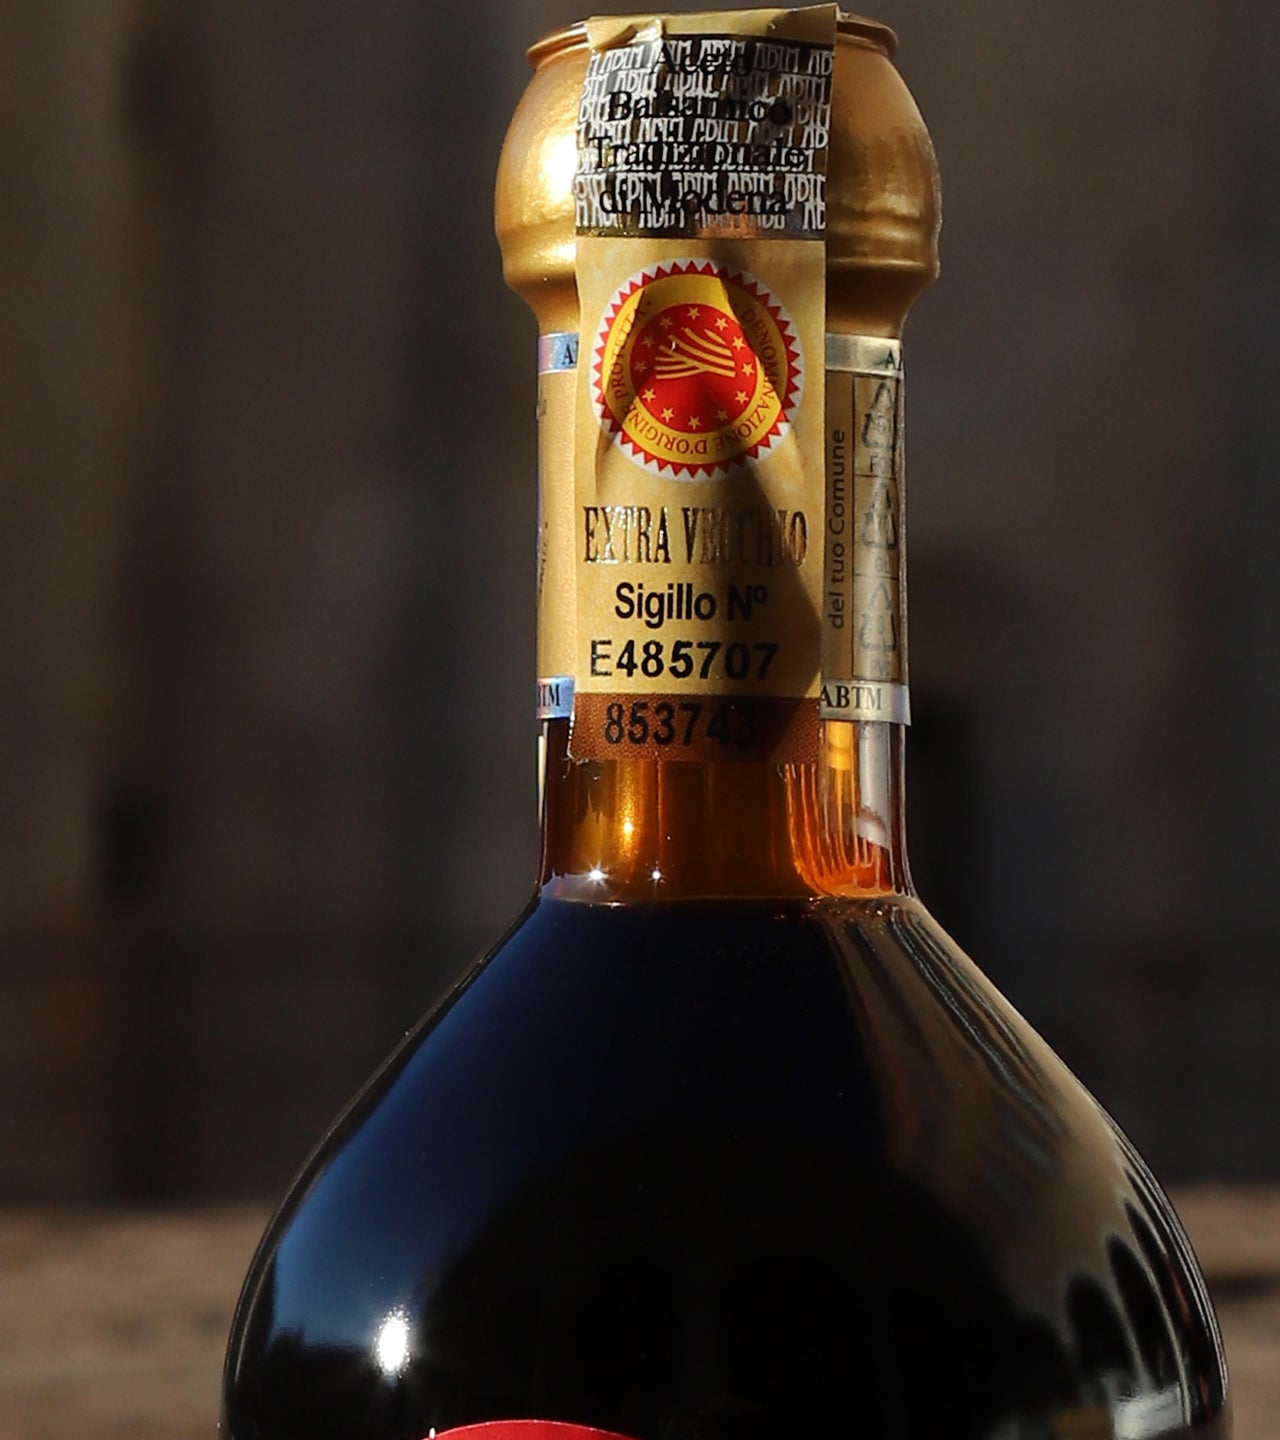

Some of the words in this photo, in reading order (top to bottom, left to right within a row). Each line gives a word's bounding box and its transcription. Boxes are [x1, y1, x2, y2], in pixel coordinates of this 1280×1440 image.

[829, 429, 845, 535] Comune
[583, 506, 672, 564] EXTRA
[831, 543, 845, 585] tuo
[614, 582, 717, 628] Sigillo
[828, 593, 845, 629] del
[590, 639, 779, 679] E485707
